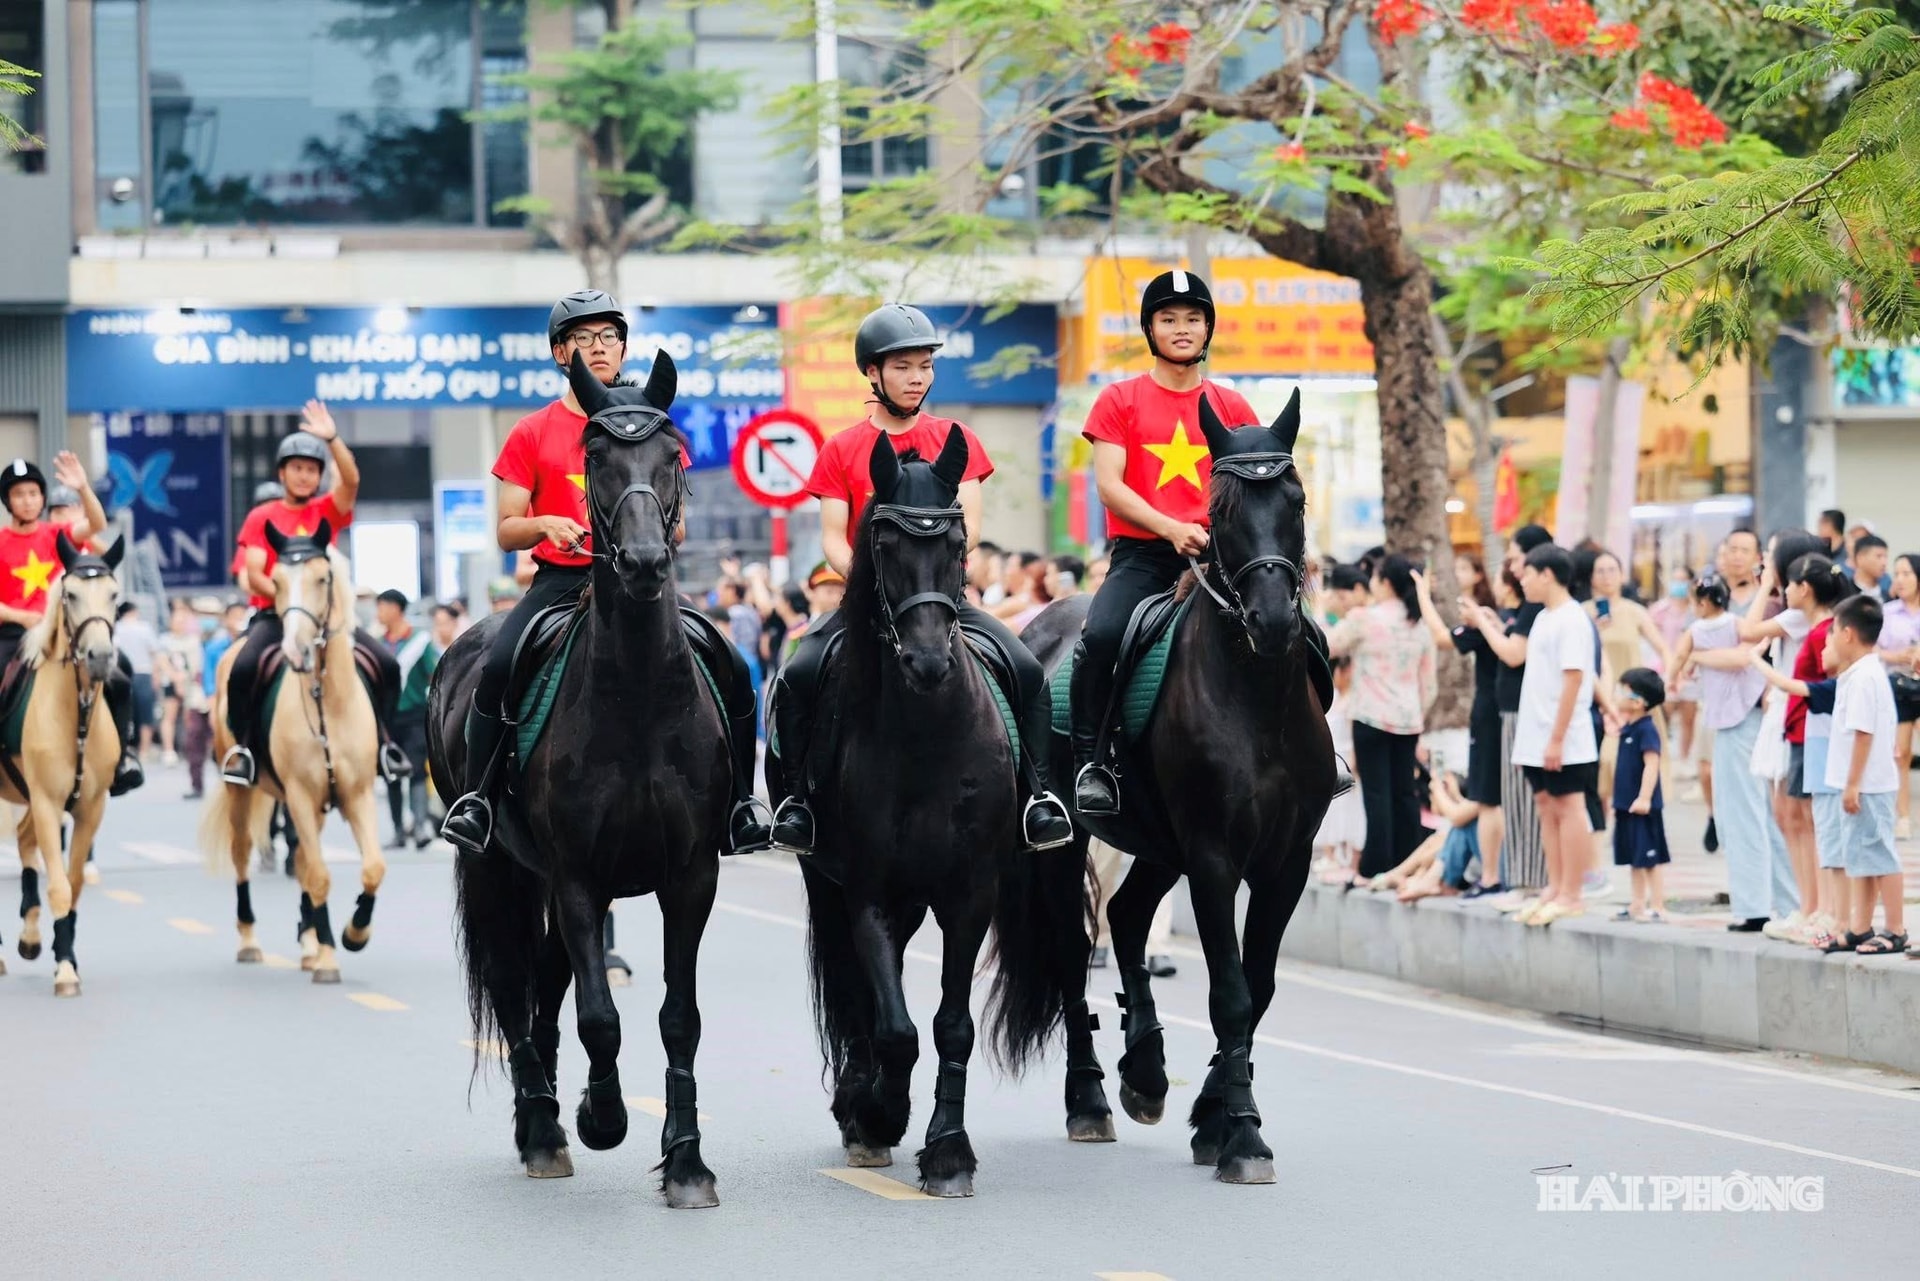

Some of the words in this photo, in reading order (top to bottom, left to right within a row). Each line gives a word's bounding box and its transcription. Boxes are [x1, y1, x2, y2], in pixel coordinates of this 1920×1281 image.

[154, 335, 210, 364] GIA
[310, 328, 416, 363] KHÁCH
[420, 334, 482, 367] SẠN
[315, 364, 379, 400] MÚT
